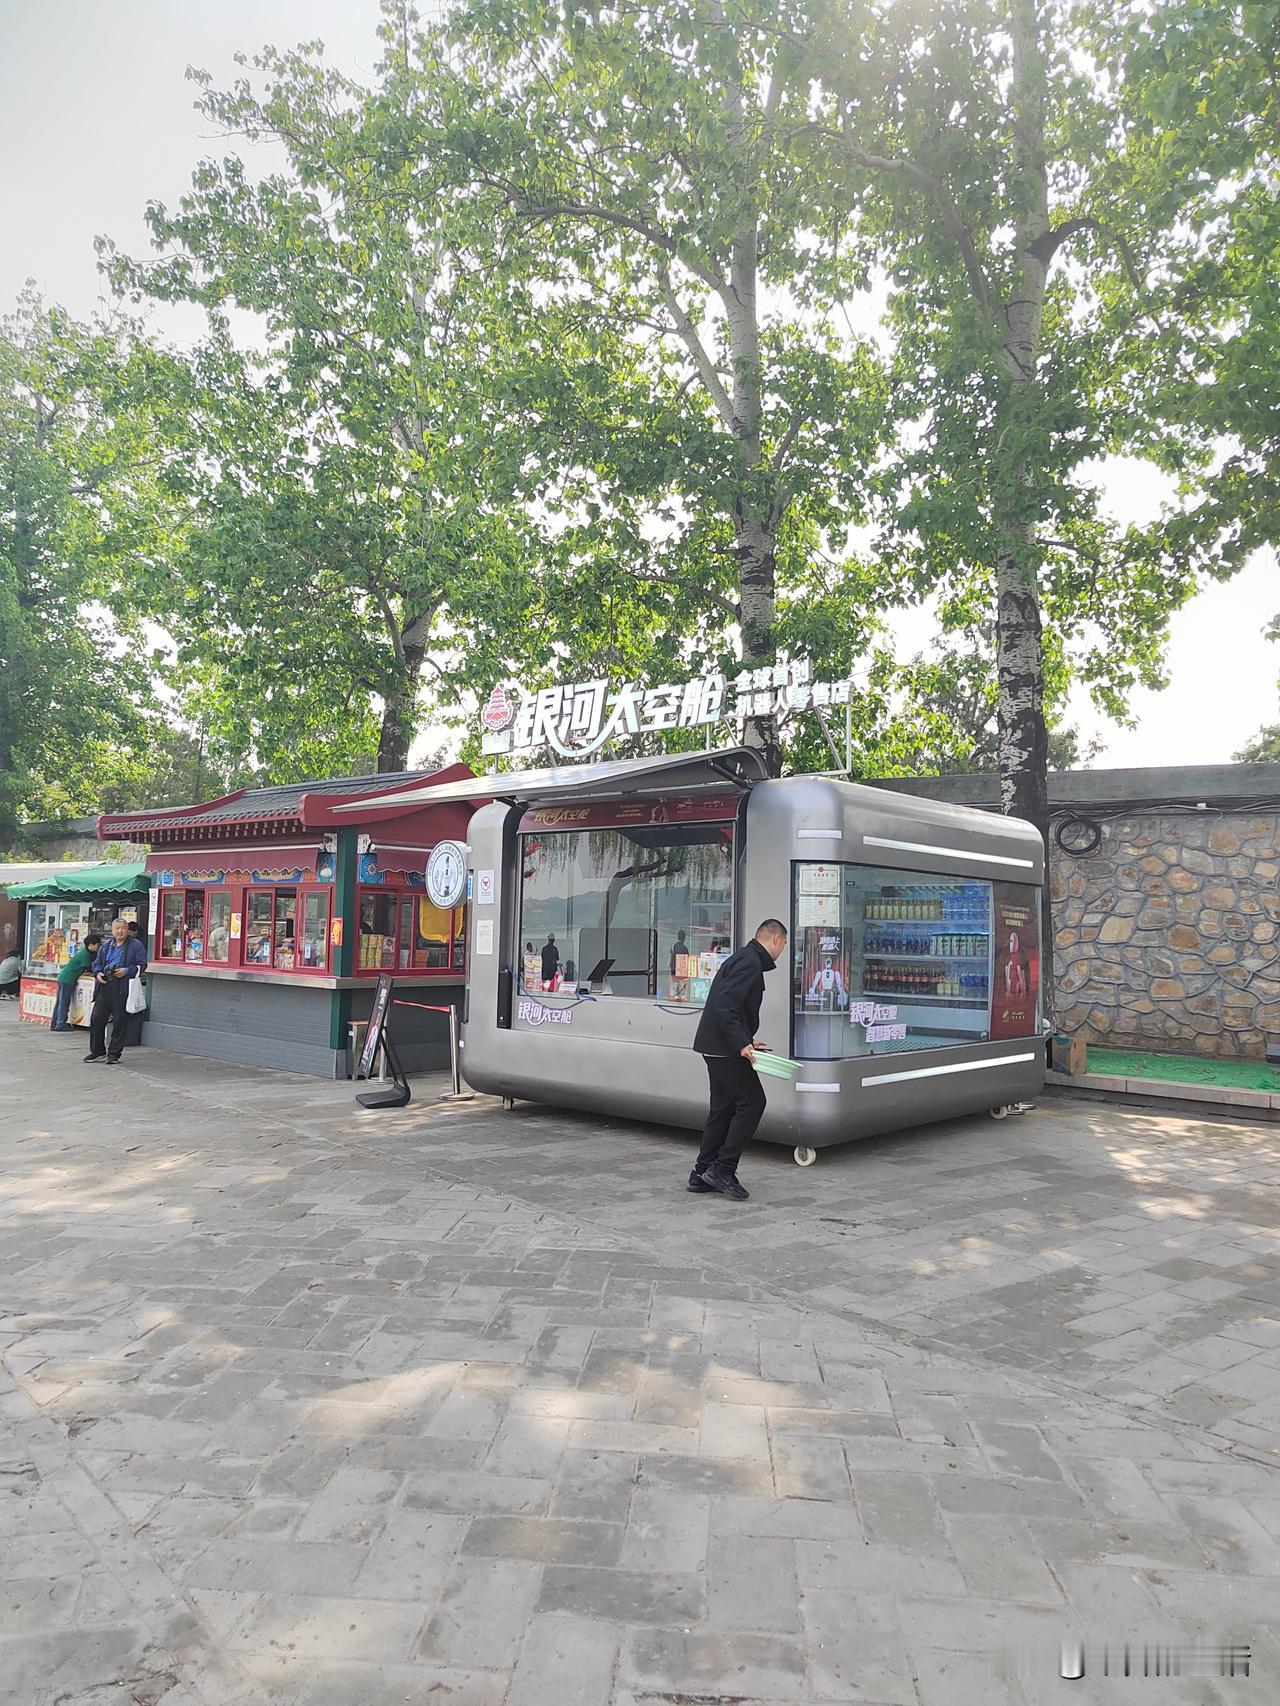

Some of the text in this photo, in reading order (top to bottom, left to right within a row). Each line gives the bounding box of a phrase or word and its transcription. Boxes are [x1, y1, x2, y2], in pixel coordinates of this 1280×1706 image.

[735, 656, 810, 692] 全球首创
[736, 679, 851, 716] 机器人零售店
[513, 674, 723, 757] 银河太空舱
[534, 808, 589, 826] 银河太空舱
[518, 1001, 572, 1026] 银河太空舱
[850, 1001, 897, 1027] 银河太空舱
